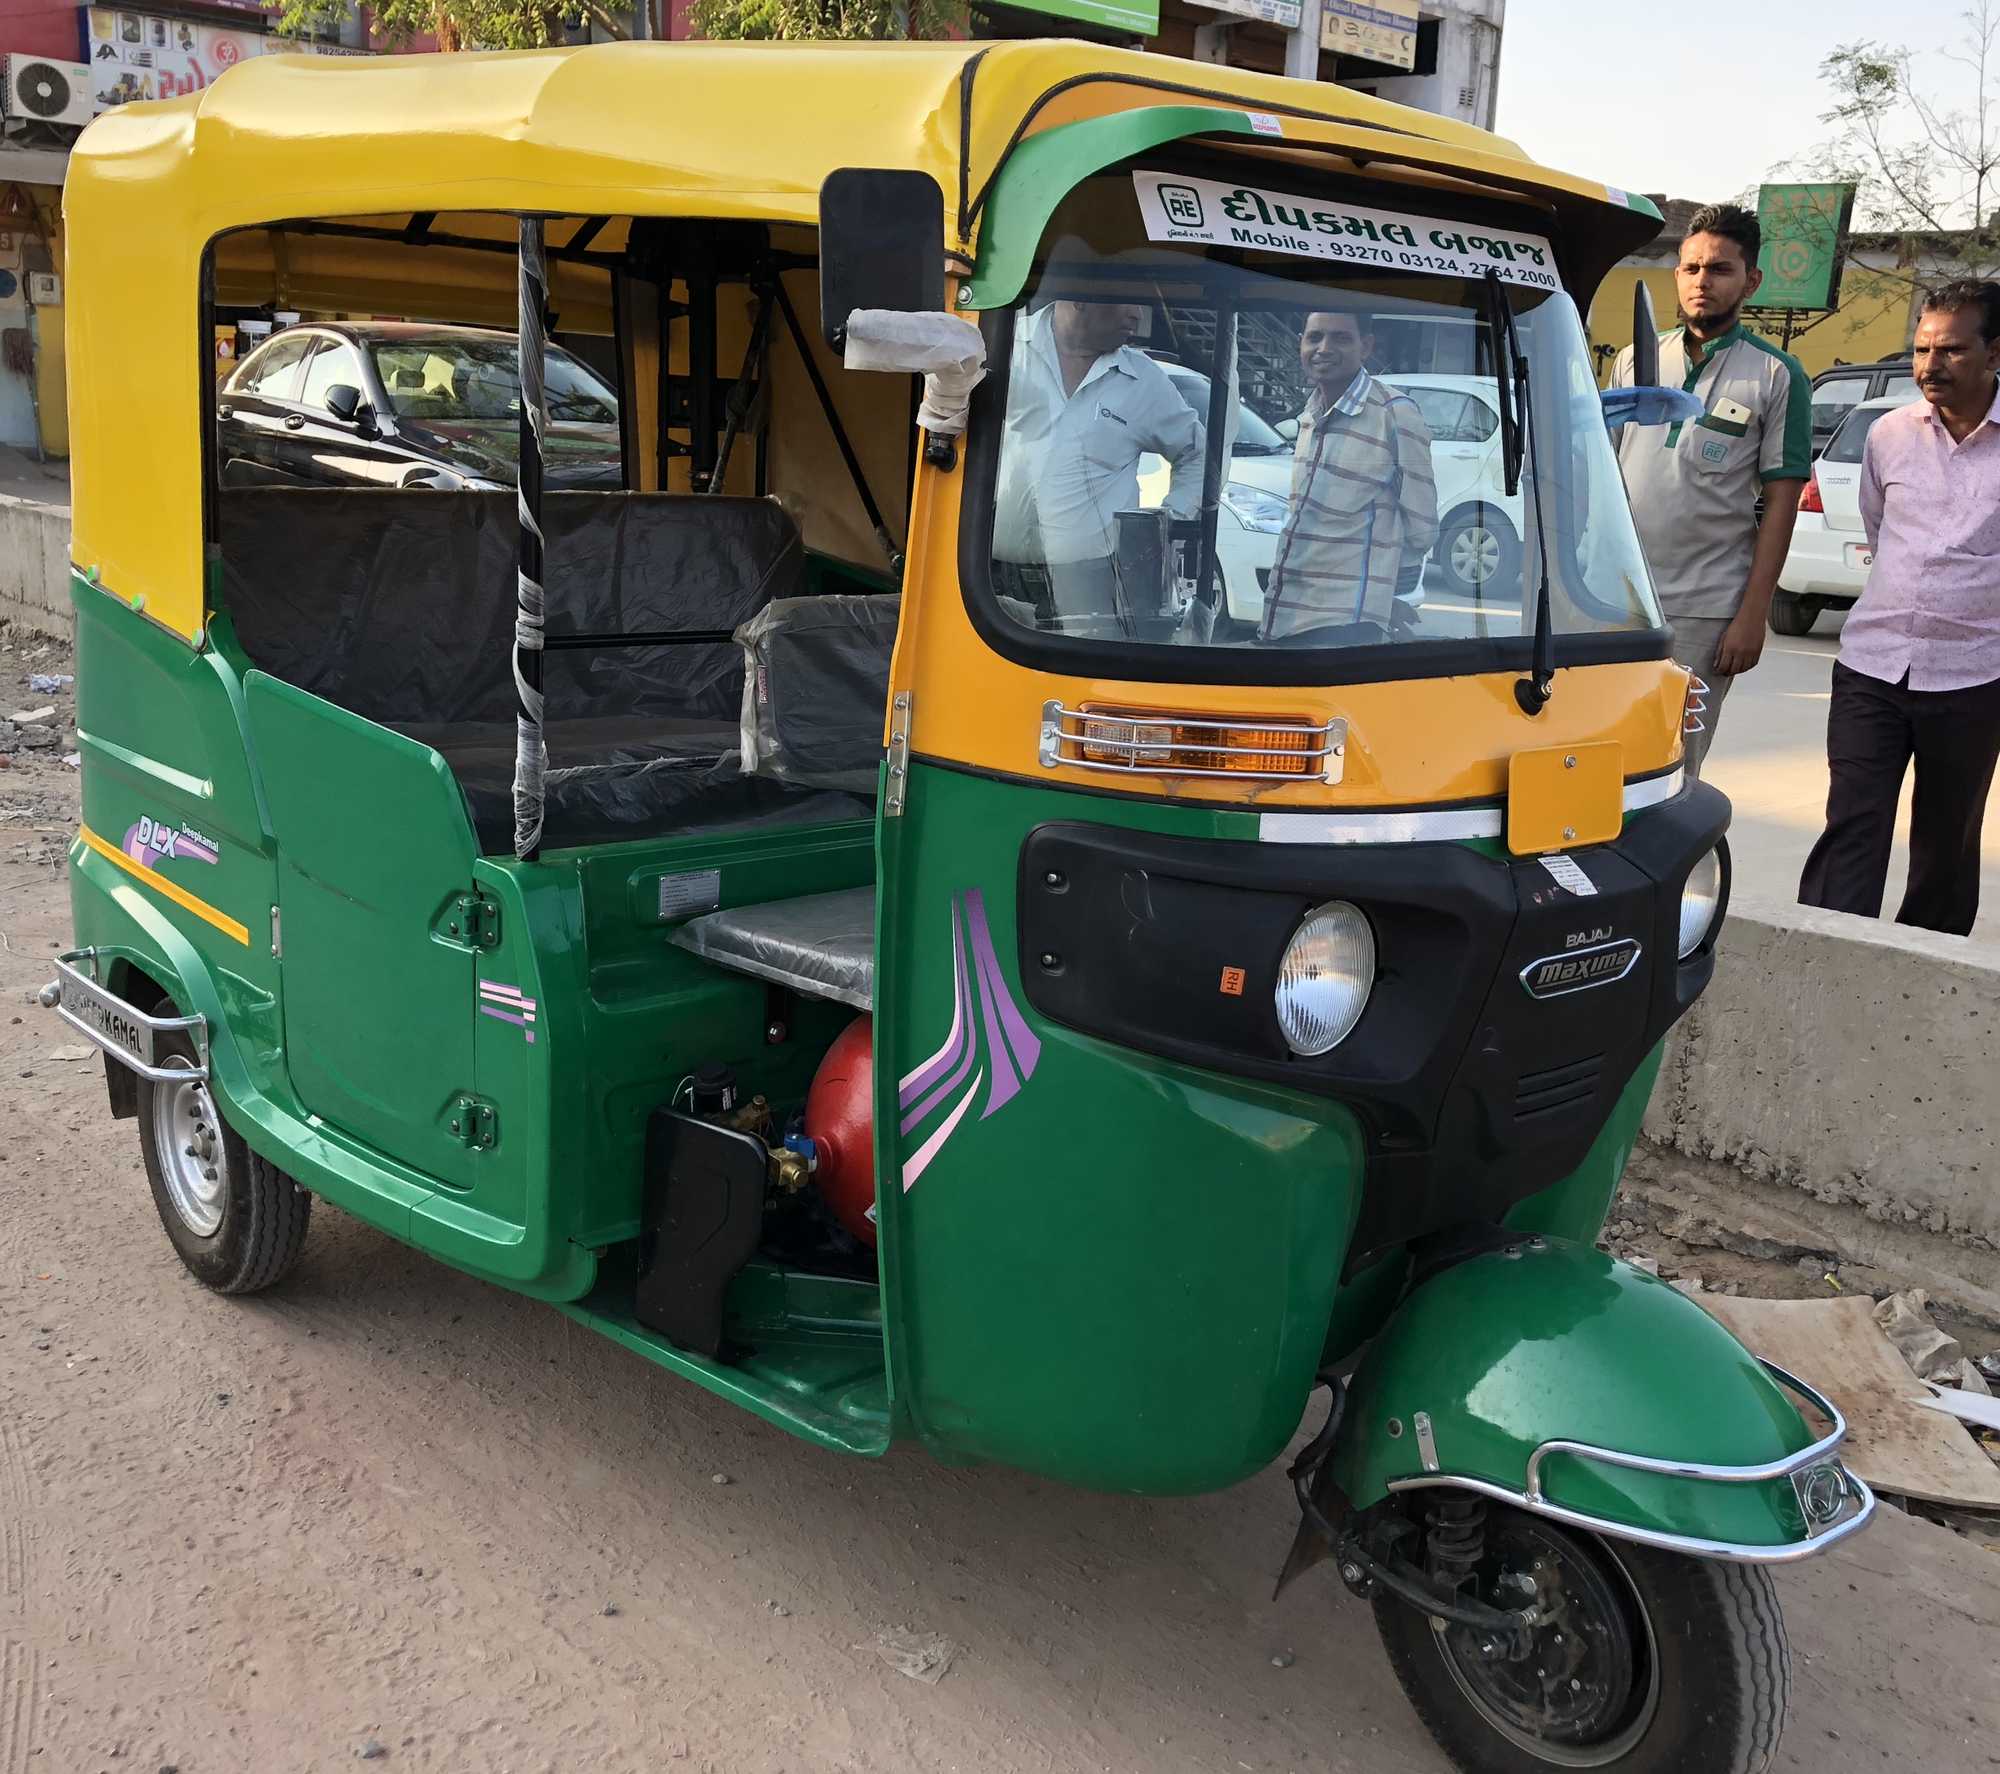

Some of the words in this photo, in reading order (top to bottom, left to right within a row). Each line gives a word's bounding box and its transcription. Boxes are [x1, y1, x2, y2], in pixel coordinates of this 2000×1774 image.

[1169, 198, 1198, 218] RE
[1220, 189, 1418, 248] દીપકમલ
[1429, 230, 1545, 266] બજાજ
[1230, 226, 1310, 251] Mobile
[1330, 241, 1394, 263] 93270
[1399, 251, 1465, 275] 03124,
[1519, 268, 1556, 287] 2000
[137, 814, 180, 860] DLX
[181, 820, 220, 854] Deepkamal
[1565, 926, 1613, 948] BAJAJ
[1226, 971, 1240, 991] RH
